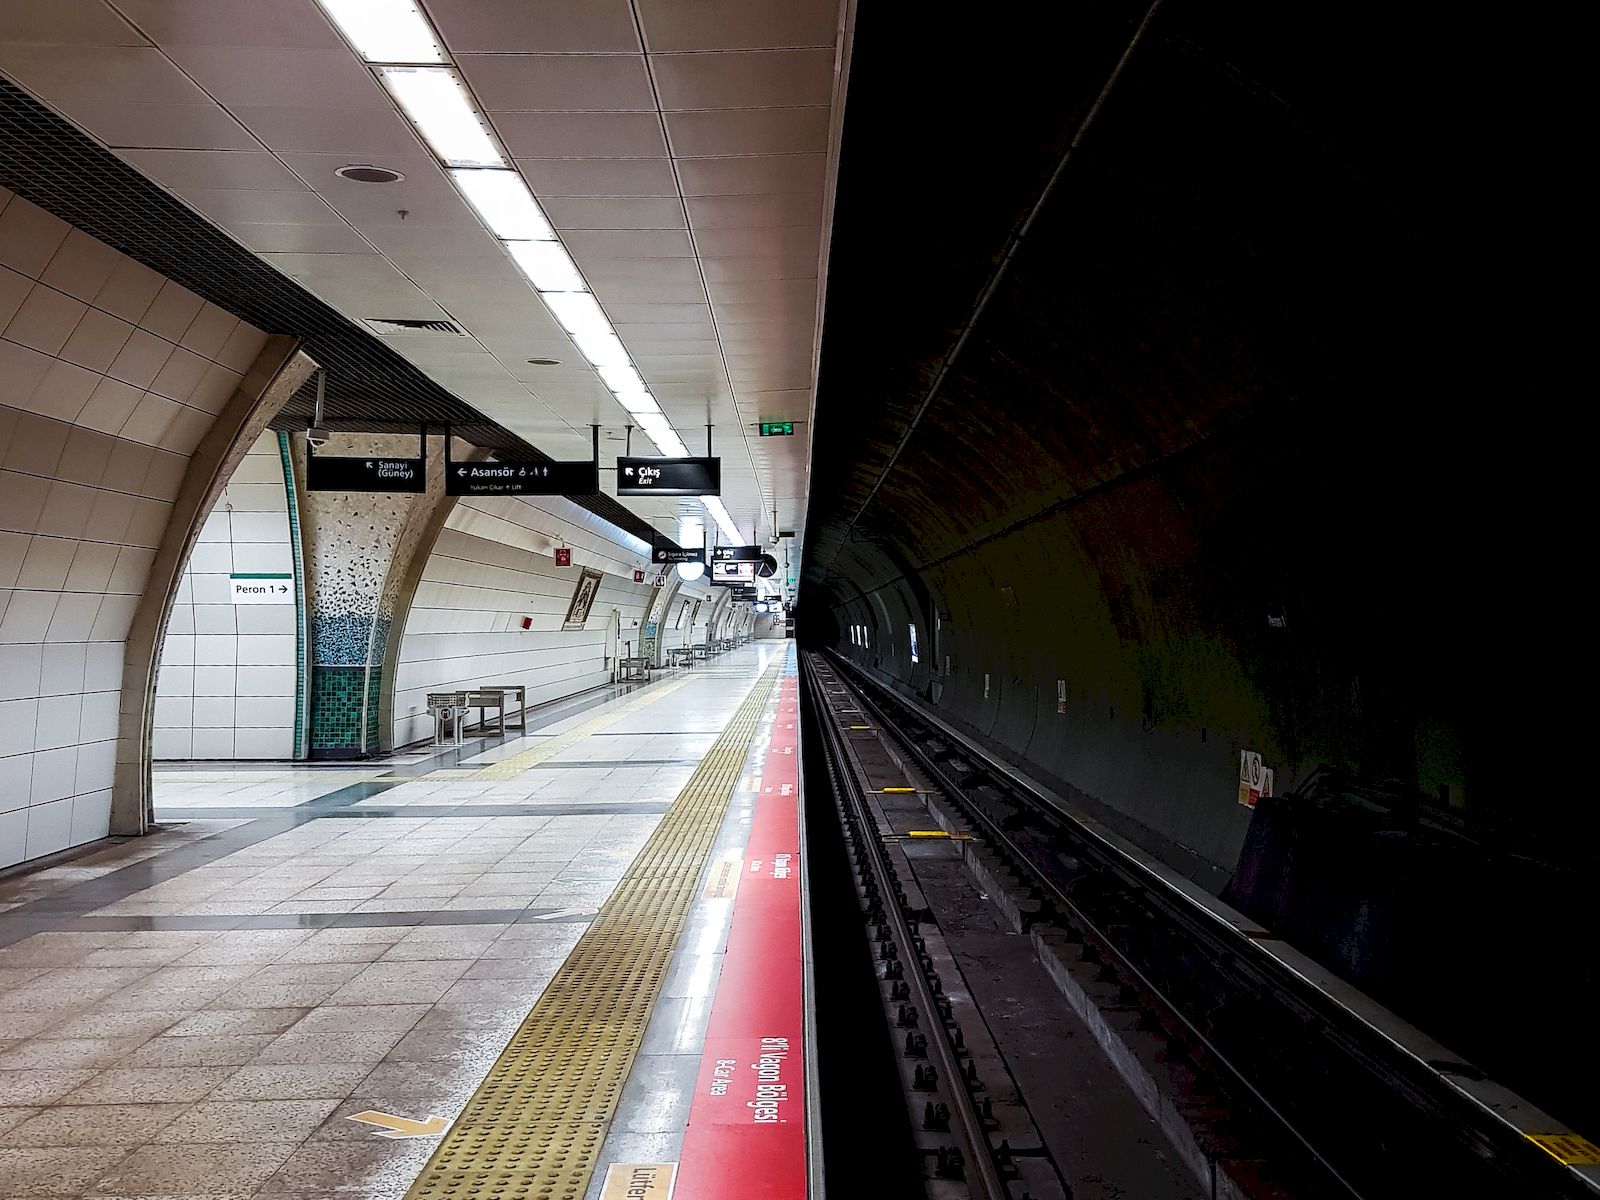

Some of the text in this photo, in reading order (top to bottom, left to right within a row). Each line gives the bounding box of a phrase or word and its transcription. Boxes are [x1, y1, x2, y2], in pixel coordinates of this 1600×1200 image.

[379, 461, 407, 470] Sanayi
[378, 469, 413, 479] (Güney)
[470, 467, 514, 477] Asansör
[638, 467, 660, 478] Çıkış
[236, 585, 274, 593] Peron 1
[710, 1059, 736, 1096] 8-Car Area
[746, 1037, 790, 1123] 8'li Vagon Bölgesi
